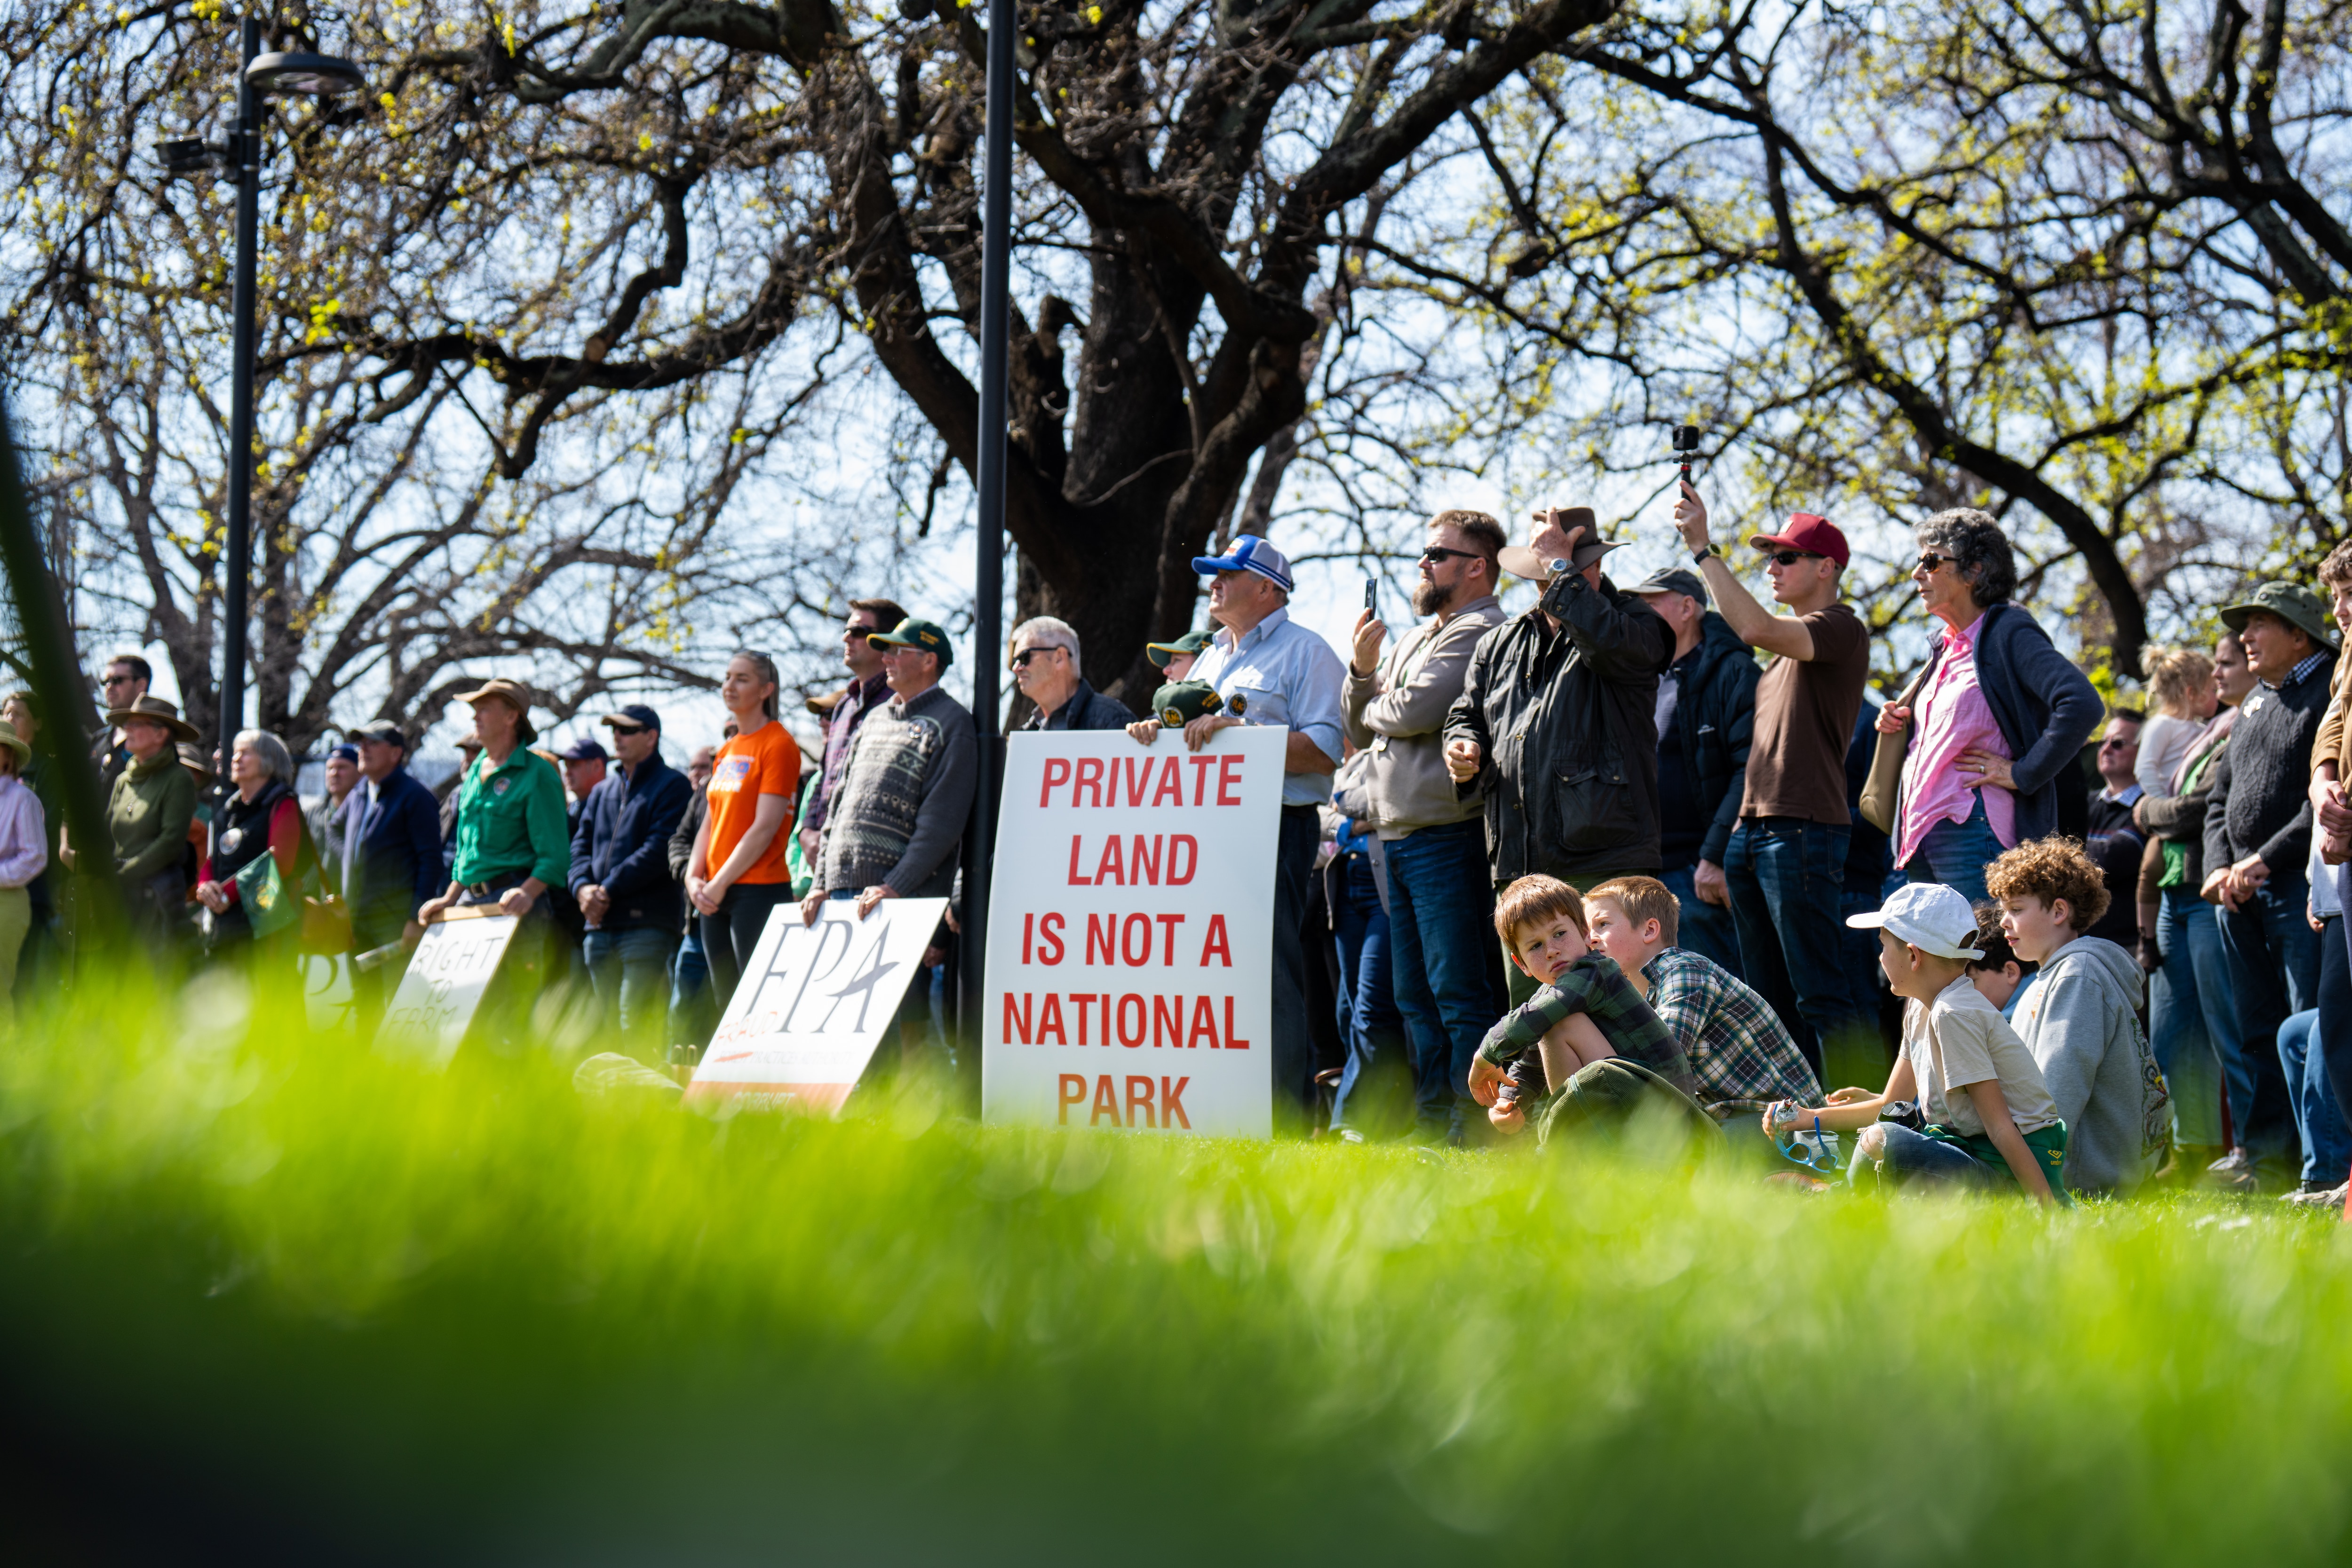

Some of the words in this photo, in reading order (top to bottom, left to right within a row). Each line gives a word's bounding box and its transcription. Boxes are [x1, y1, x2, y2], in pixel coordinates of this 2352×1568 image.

[1039, 754, 1245, 809] PRIVATE
[1067, 834, 1198, 886] LAND
[409, 936, 505, 976] RIGHT
[1022, 912, 1066, 966] IS
[1085, 913, 1185, 968] NOT
[1199, 914, 1232, 968] A
[425, 978, 453, 1006] TO
[384, 1004, 459, 1039] FARM
[714, 1011, 778, 1049] FRAUD
[1002, 991, 1250, 1050] NATIONAL
[1058, 1073, 1192, 1130] PARK
